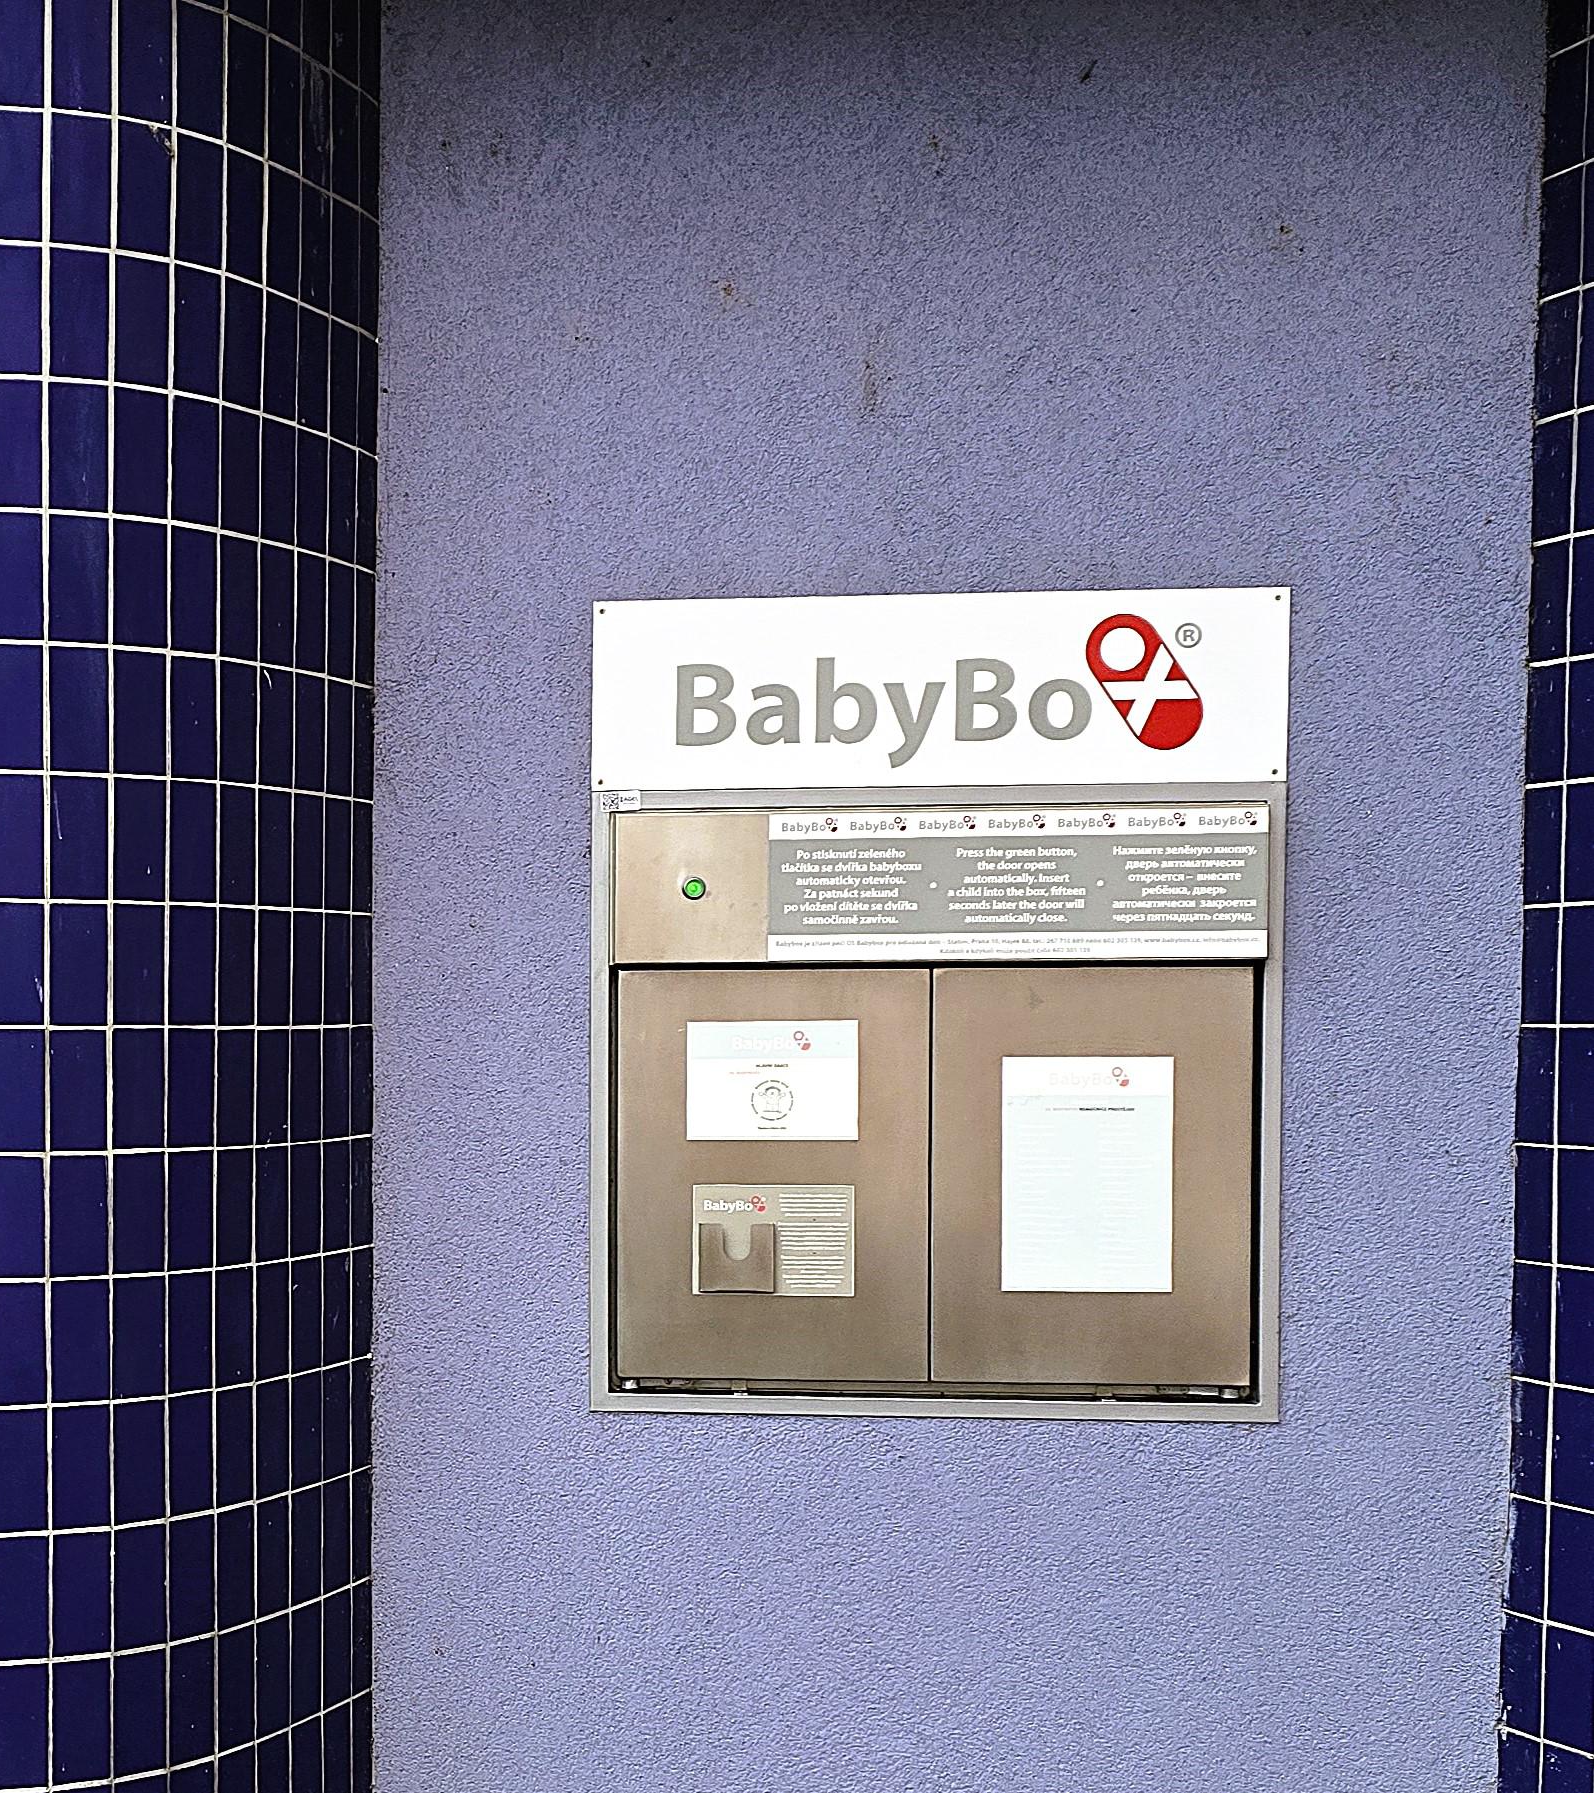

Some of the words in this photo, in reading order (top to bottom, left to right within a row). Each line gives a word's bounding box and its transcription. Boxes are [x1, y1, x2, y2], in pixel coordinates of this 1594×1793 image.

[797, 850, 810, 859] Po
[858, 848, 905, 858] zeleného
[956, 848, 984, 857] Press
[986, 847, 1003, 856] the
[1005, 849, 1035, 859] green
[1038, 847, 1077, 857] button,
[977, 861, 995, 870] the
[997, 861, 1022, 869] door
[1024, 861, 1056, 871] opens
[1125, 860, 1159, 870] дверь
[796, 875, 860, 887] automaticky
[964, 873, 1037, 885] automatically.
[1039, 874, 1070, 882] Insert
[804, 889, 816, 898] Za
[818, 889, 858, 900] patnáct
[860, 888, 898, 897] sekund
[956, 887, 981, 896] child
[983, 888, 1004, 896] into
[1006, 887, 1024, 896] the
[1026, 887, 1049, 896] box,
[1051, 887, 1086, 896] fifteen
[1192, 886, 1227, 896] дверь
[784, 904, 798, 914] po
[949, 900, 991, 910] seconds
[992, 900, 1017, 909] later
[1019, 900, 1036, 909] the
[1038, 900, 1064, 908] door
[1065, 899, 1084, 908] will
[964, 913, 1036, 924] automatically
[1038, 913, 1067, 922] close.
